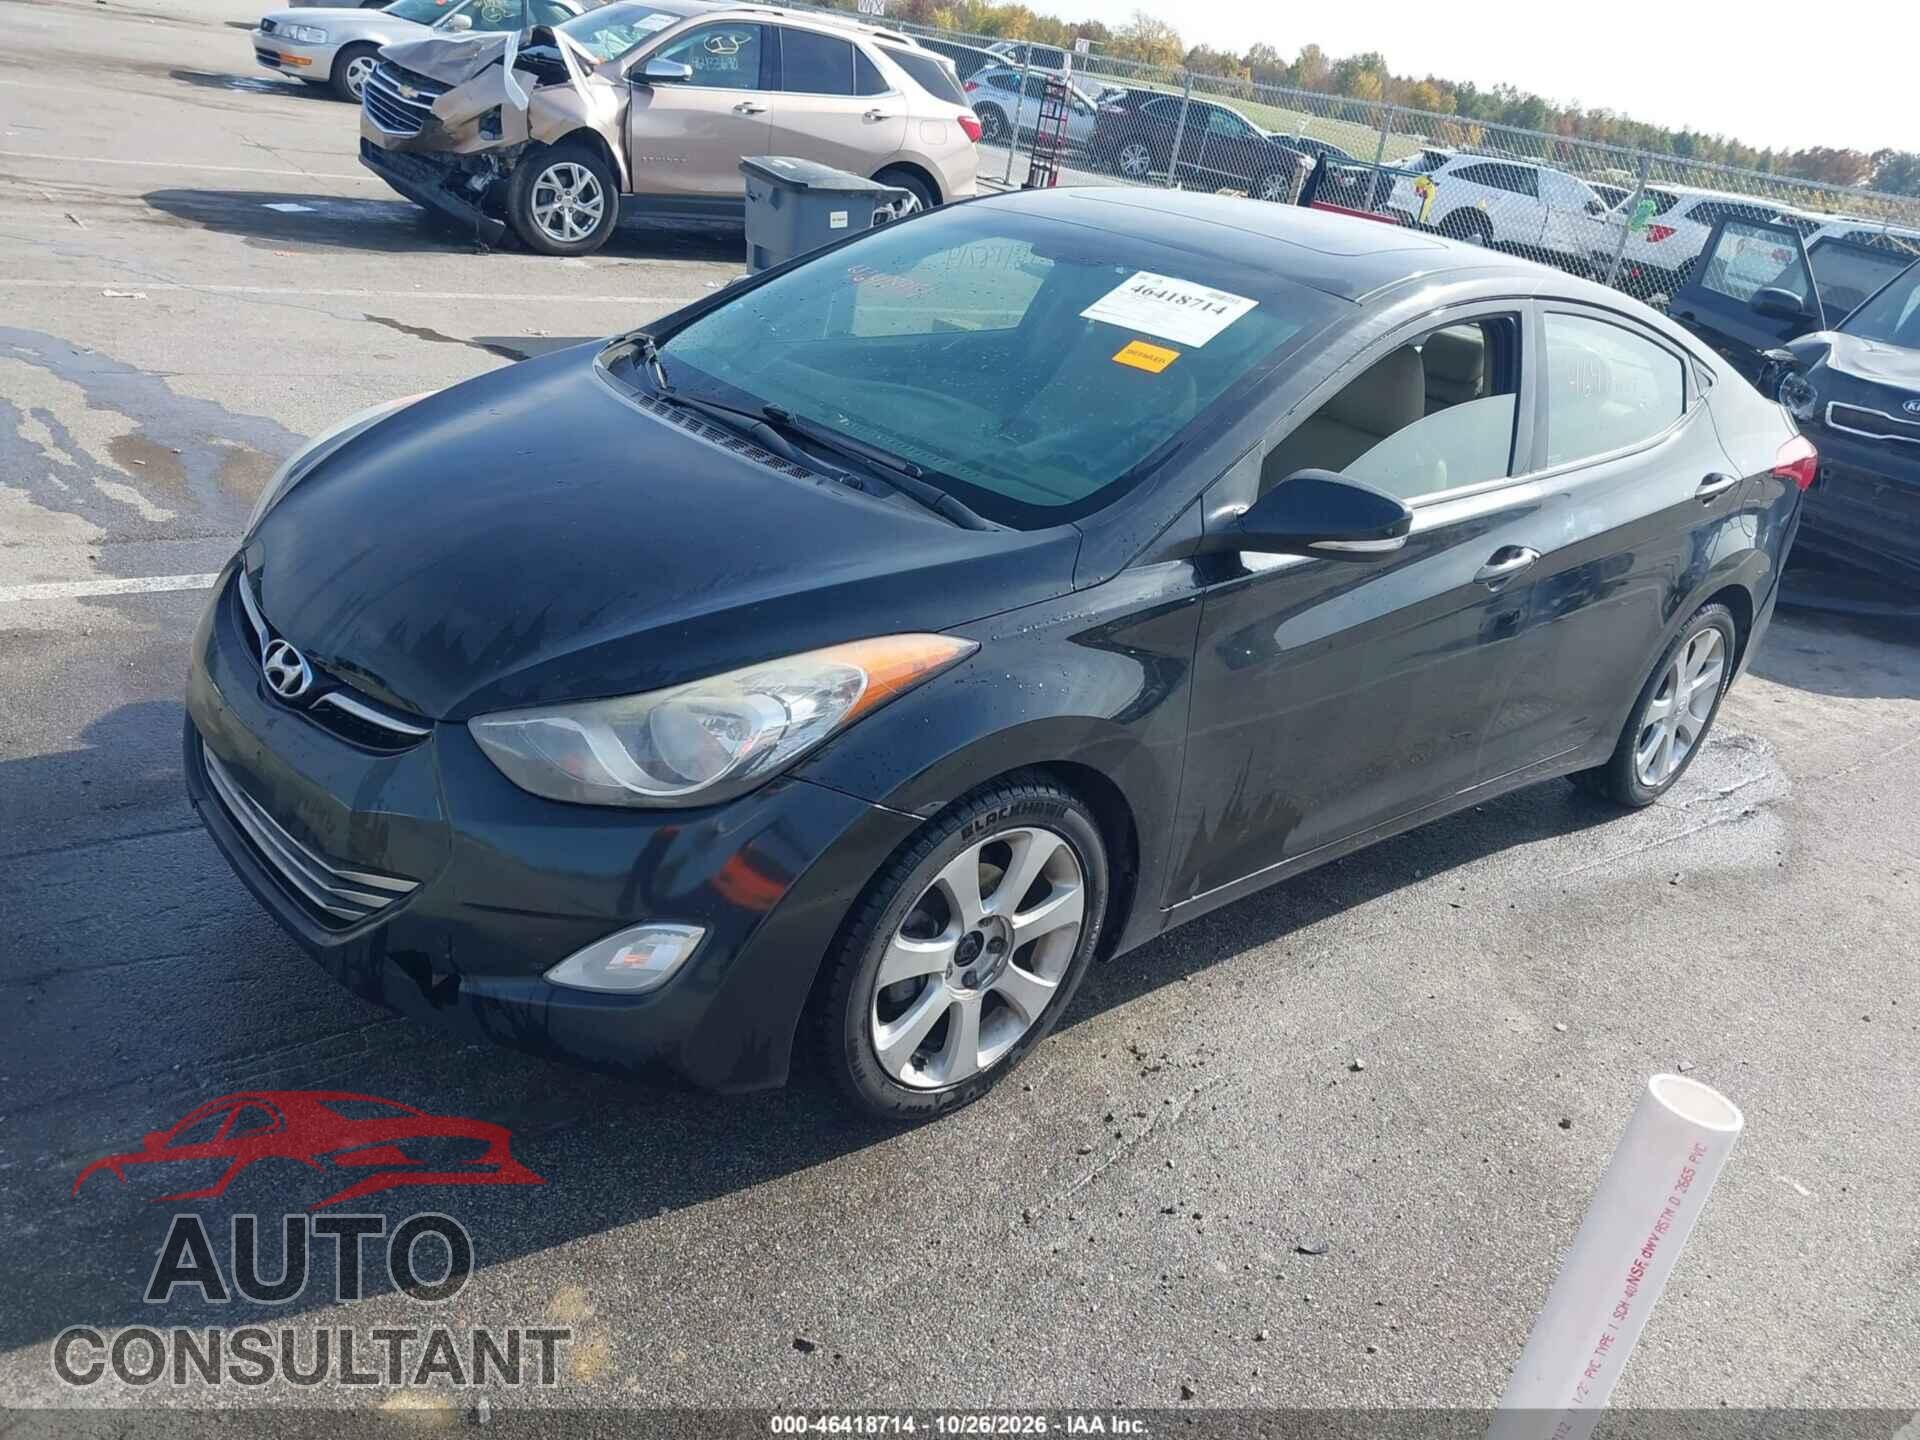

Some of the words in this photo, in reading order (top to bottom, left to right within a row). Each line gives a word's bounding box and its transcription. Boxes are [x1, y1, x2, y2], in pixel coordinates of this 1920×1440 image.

[1131, 284, 1229, 315] 46418714
[1594, 1332, 1616, 1357] TYPE
[1674, 1166, 1697, 1195] 2665
